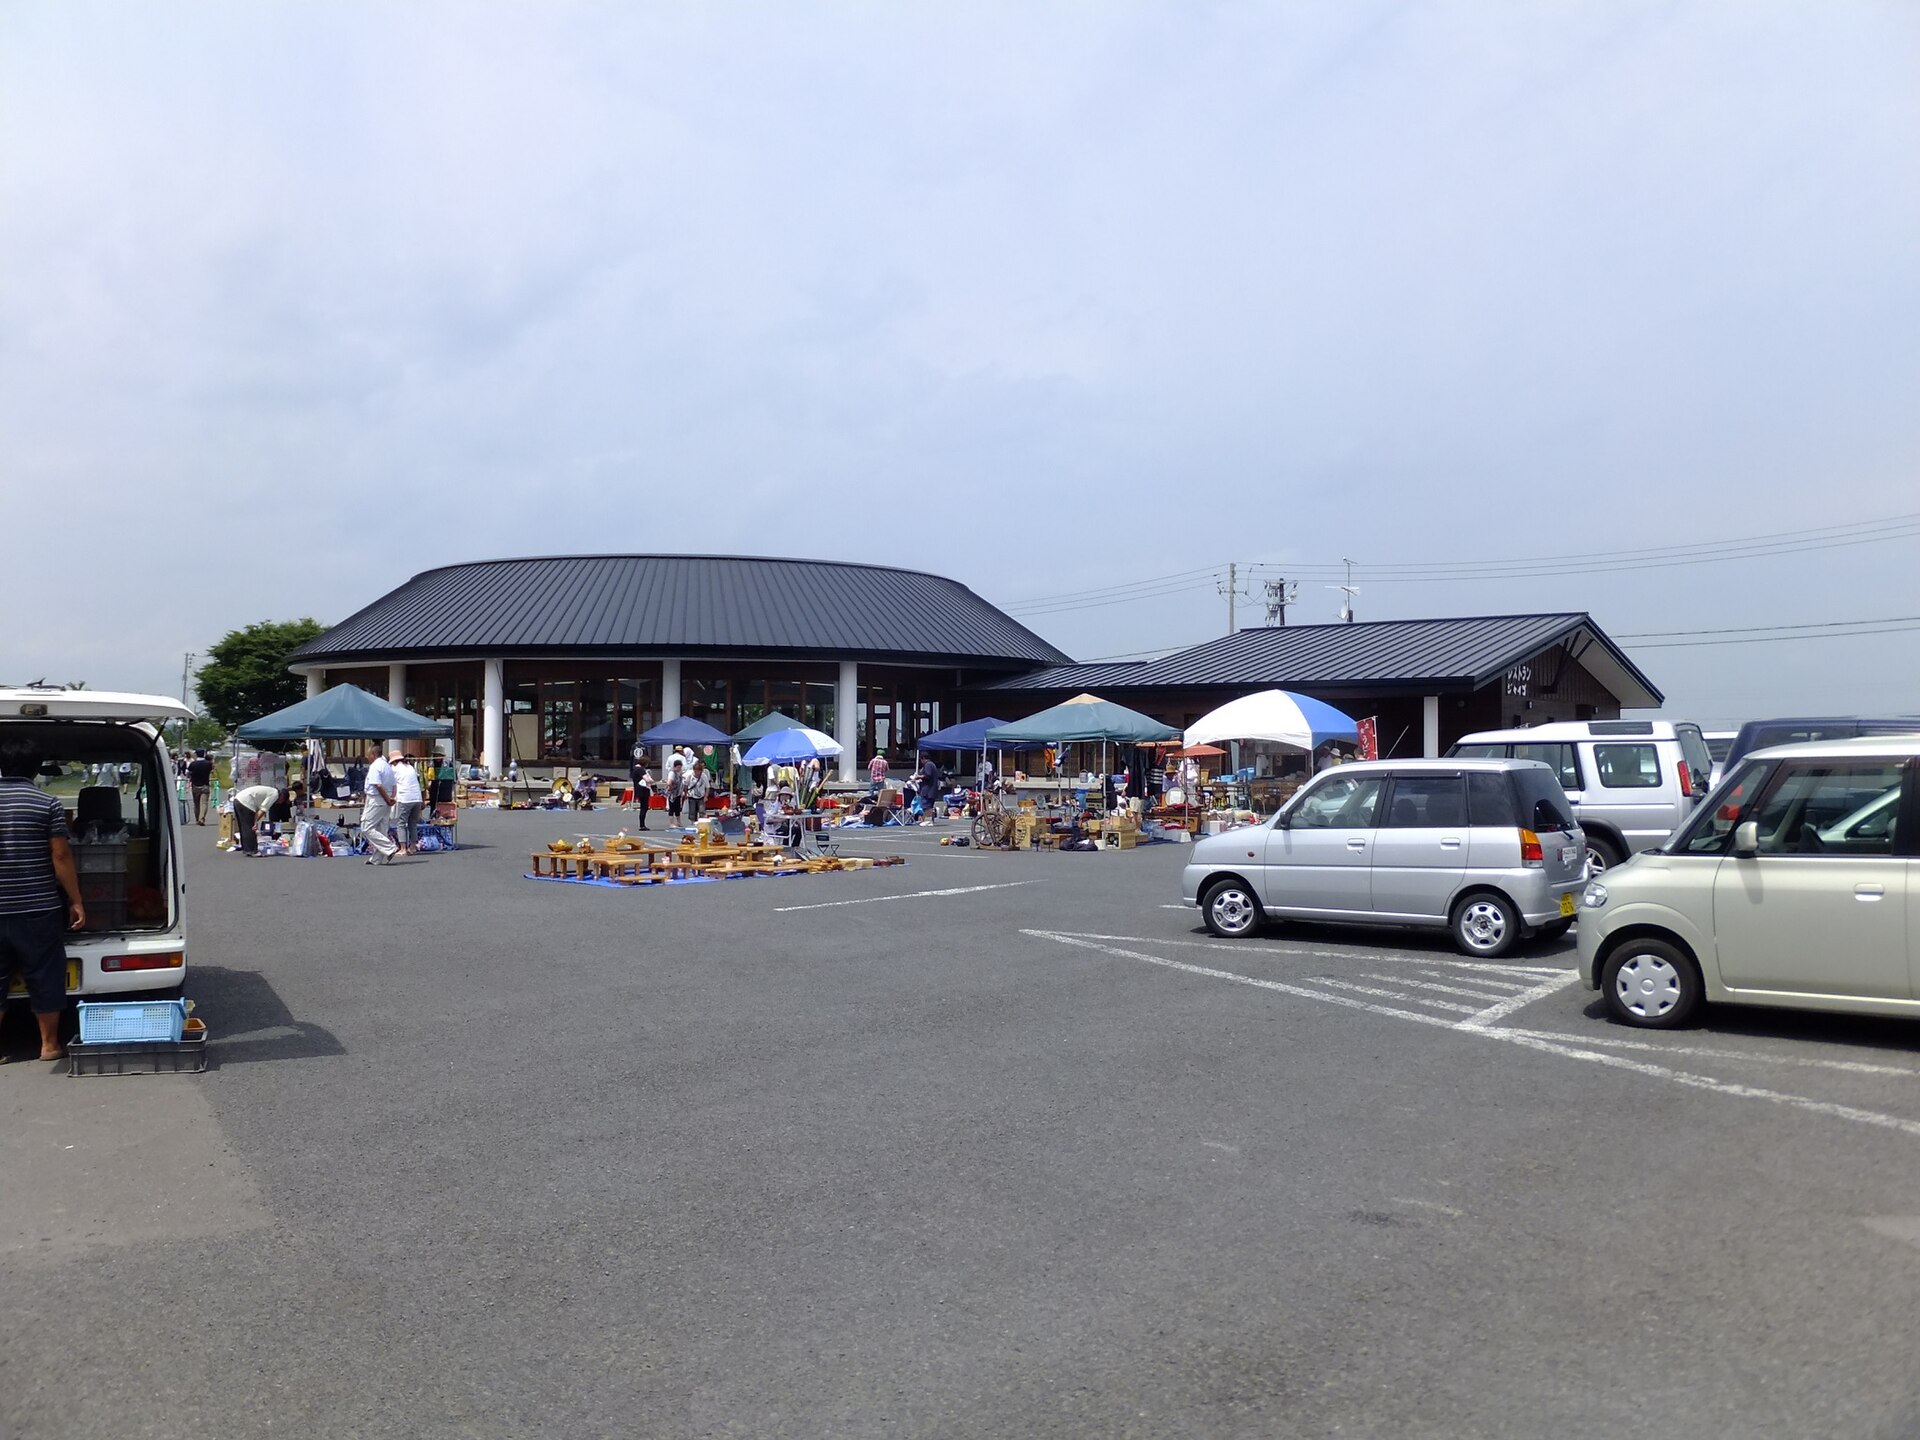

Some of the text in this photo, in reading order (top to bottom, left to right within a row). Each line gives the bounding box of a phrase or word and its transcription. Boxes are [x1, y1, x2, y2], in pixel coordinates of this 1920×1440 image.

[1507, 665, 1531, 681] レストラン
